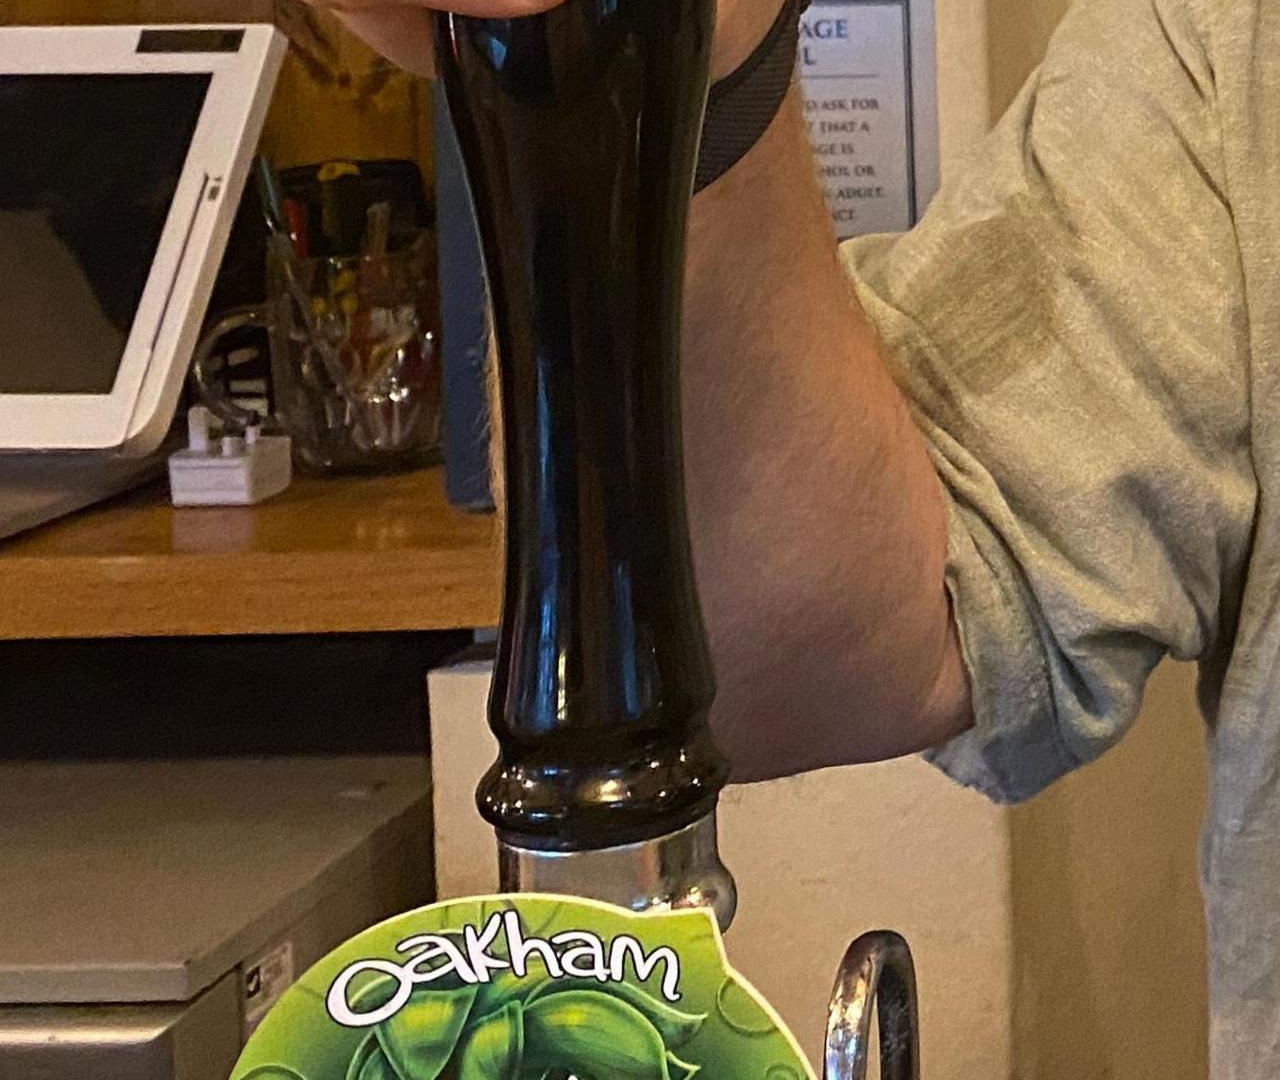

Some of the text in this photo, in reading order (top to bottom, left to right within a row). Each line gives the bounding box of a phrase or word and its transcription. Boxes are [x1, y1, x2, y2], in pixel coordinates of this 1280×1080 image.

[821, 98, 850, 112] ASK
[850, 97, 879, 111] FOR
[819, 120, 857, 133] THAT
[859, 120, 870, 132] A
[841, 142, 855, 155] IS
[325, 910, 681, 1028] Oakham
